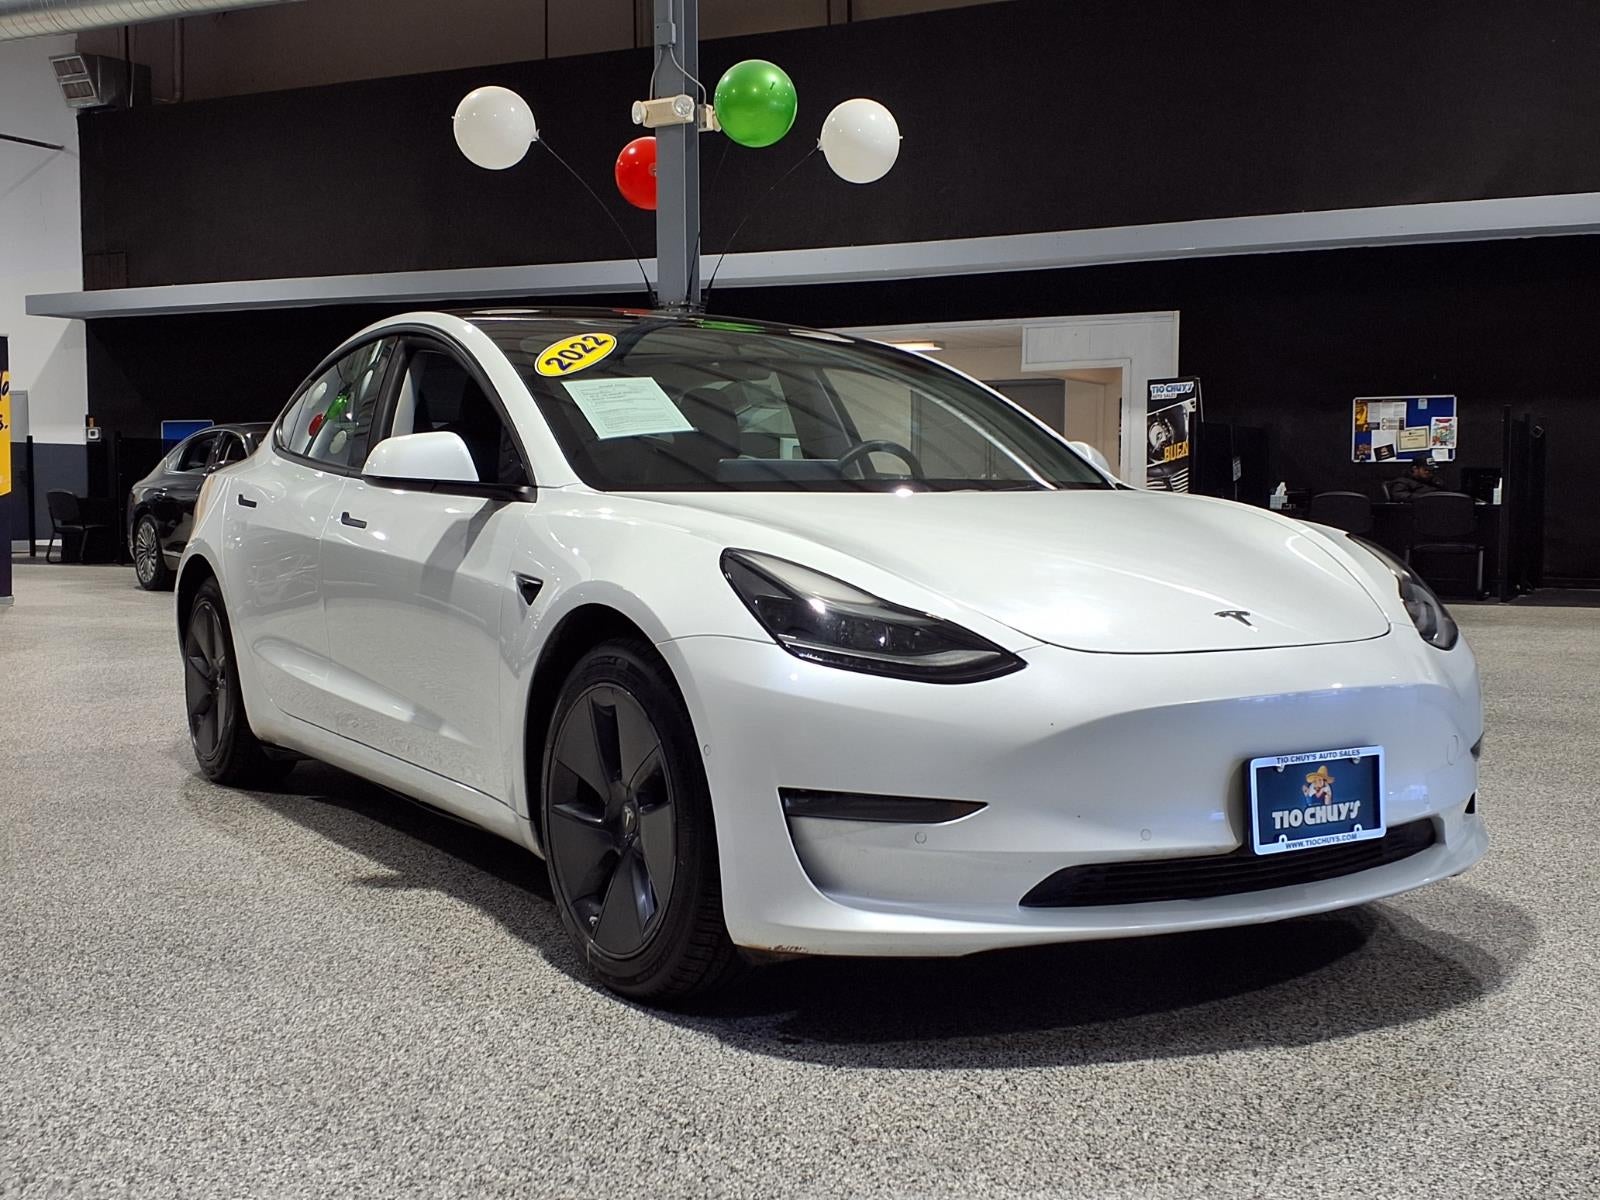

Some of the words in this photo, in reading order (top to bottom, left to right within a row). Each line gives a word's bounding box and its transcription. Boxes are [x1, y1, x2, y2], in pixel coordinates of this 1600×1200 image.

[545, 335, 608, 371] 2022
[1152, 385, 1165, 394] TIO
[1276, 757, 1289, 765] TIO
[1290, 753, 1317, 763] CHUY'S
[1318, 751, 1338, 760] AUTO
[1339, 749, 1360, 757] SALES
